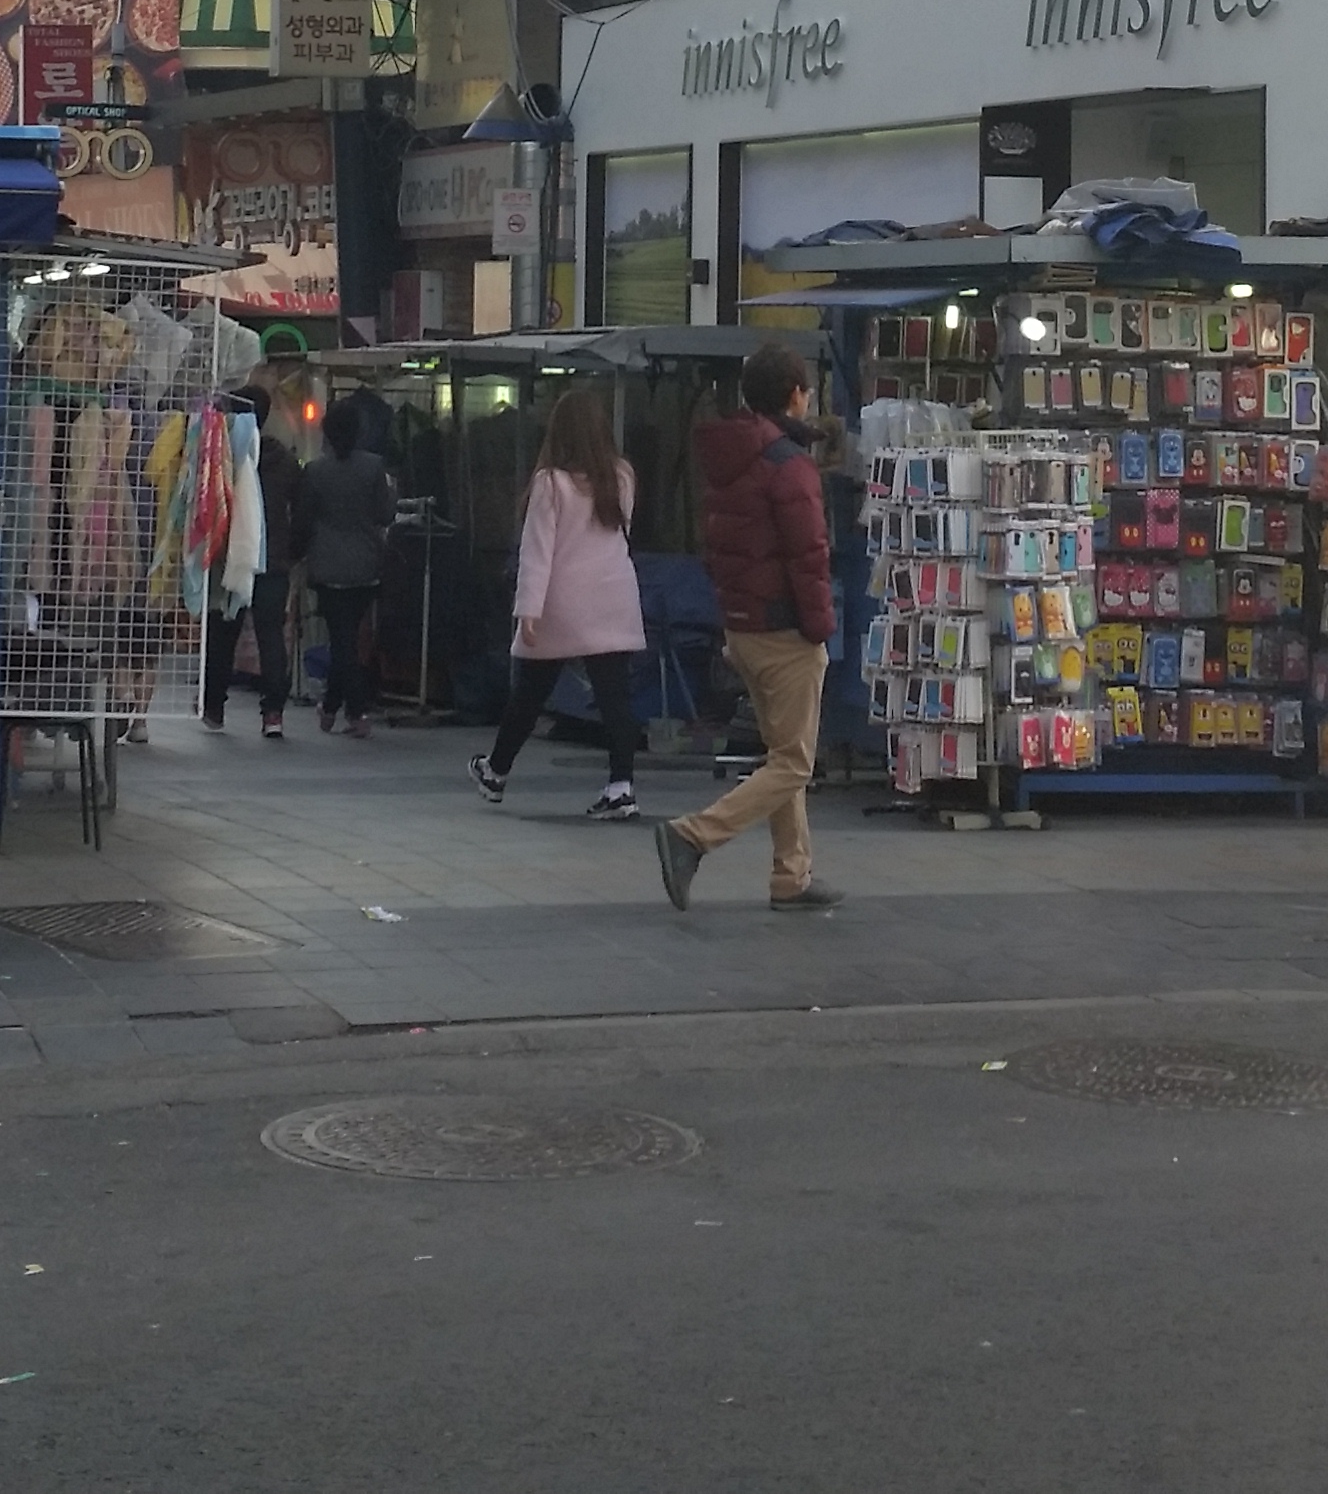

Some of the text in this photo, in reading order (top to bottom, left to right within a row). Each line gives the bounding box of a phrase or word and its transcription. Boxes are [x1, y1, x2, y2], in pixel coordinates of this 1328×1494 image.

[286, 15, 364, 39] 성형외과
[293, 43, 355, 63] 피부과
[65, 106, 101, 117] OPTICAL
